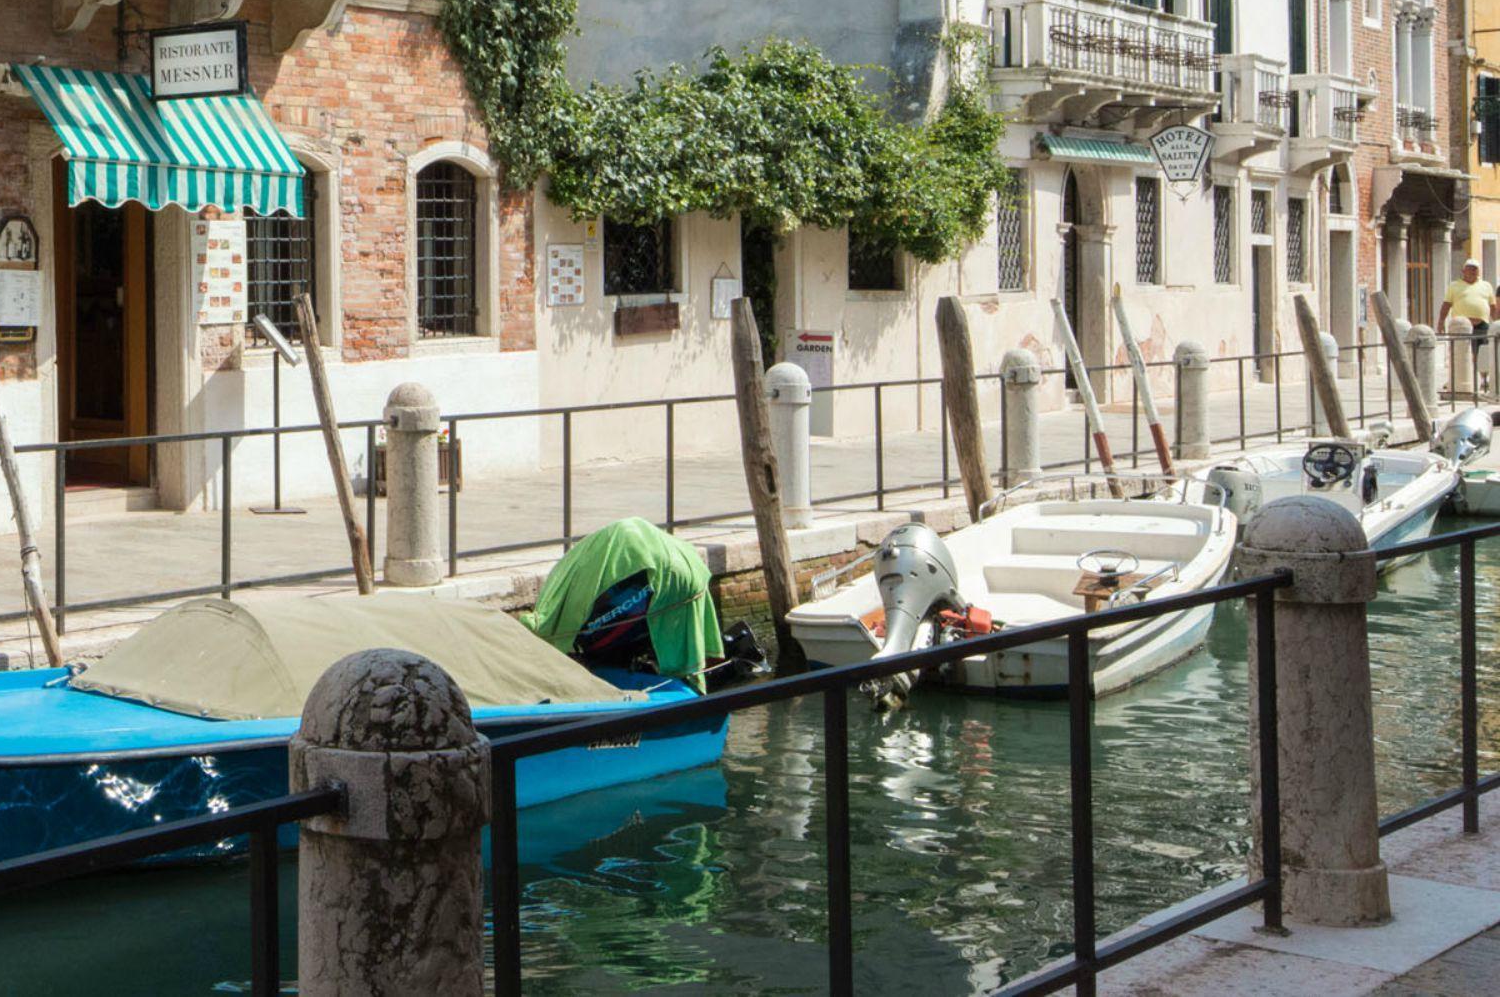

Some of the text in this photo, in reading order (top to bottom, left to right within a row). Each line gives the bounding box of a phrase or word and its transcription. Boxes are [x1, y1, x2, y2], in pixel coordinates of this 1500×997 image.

[159, 41, 235, 59] RISTORANTE
[160, 63, 235, 83] MESSNER
[1155, 130, 1202, 147] HOTEL
[796, 343, 834, 353] GARDEN
